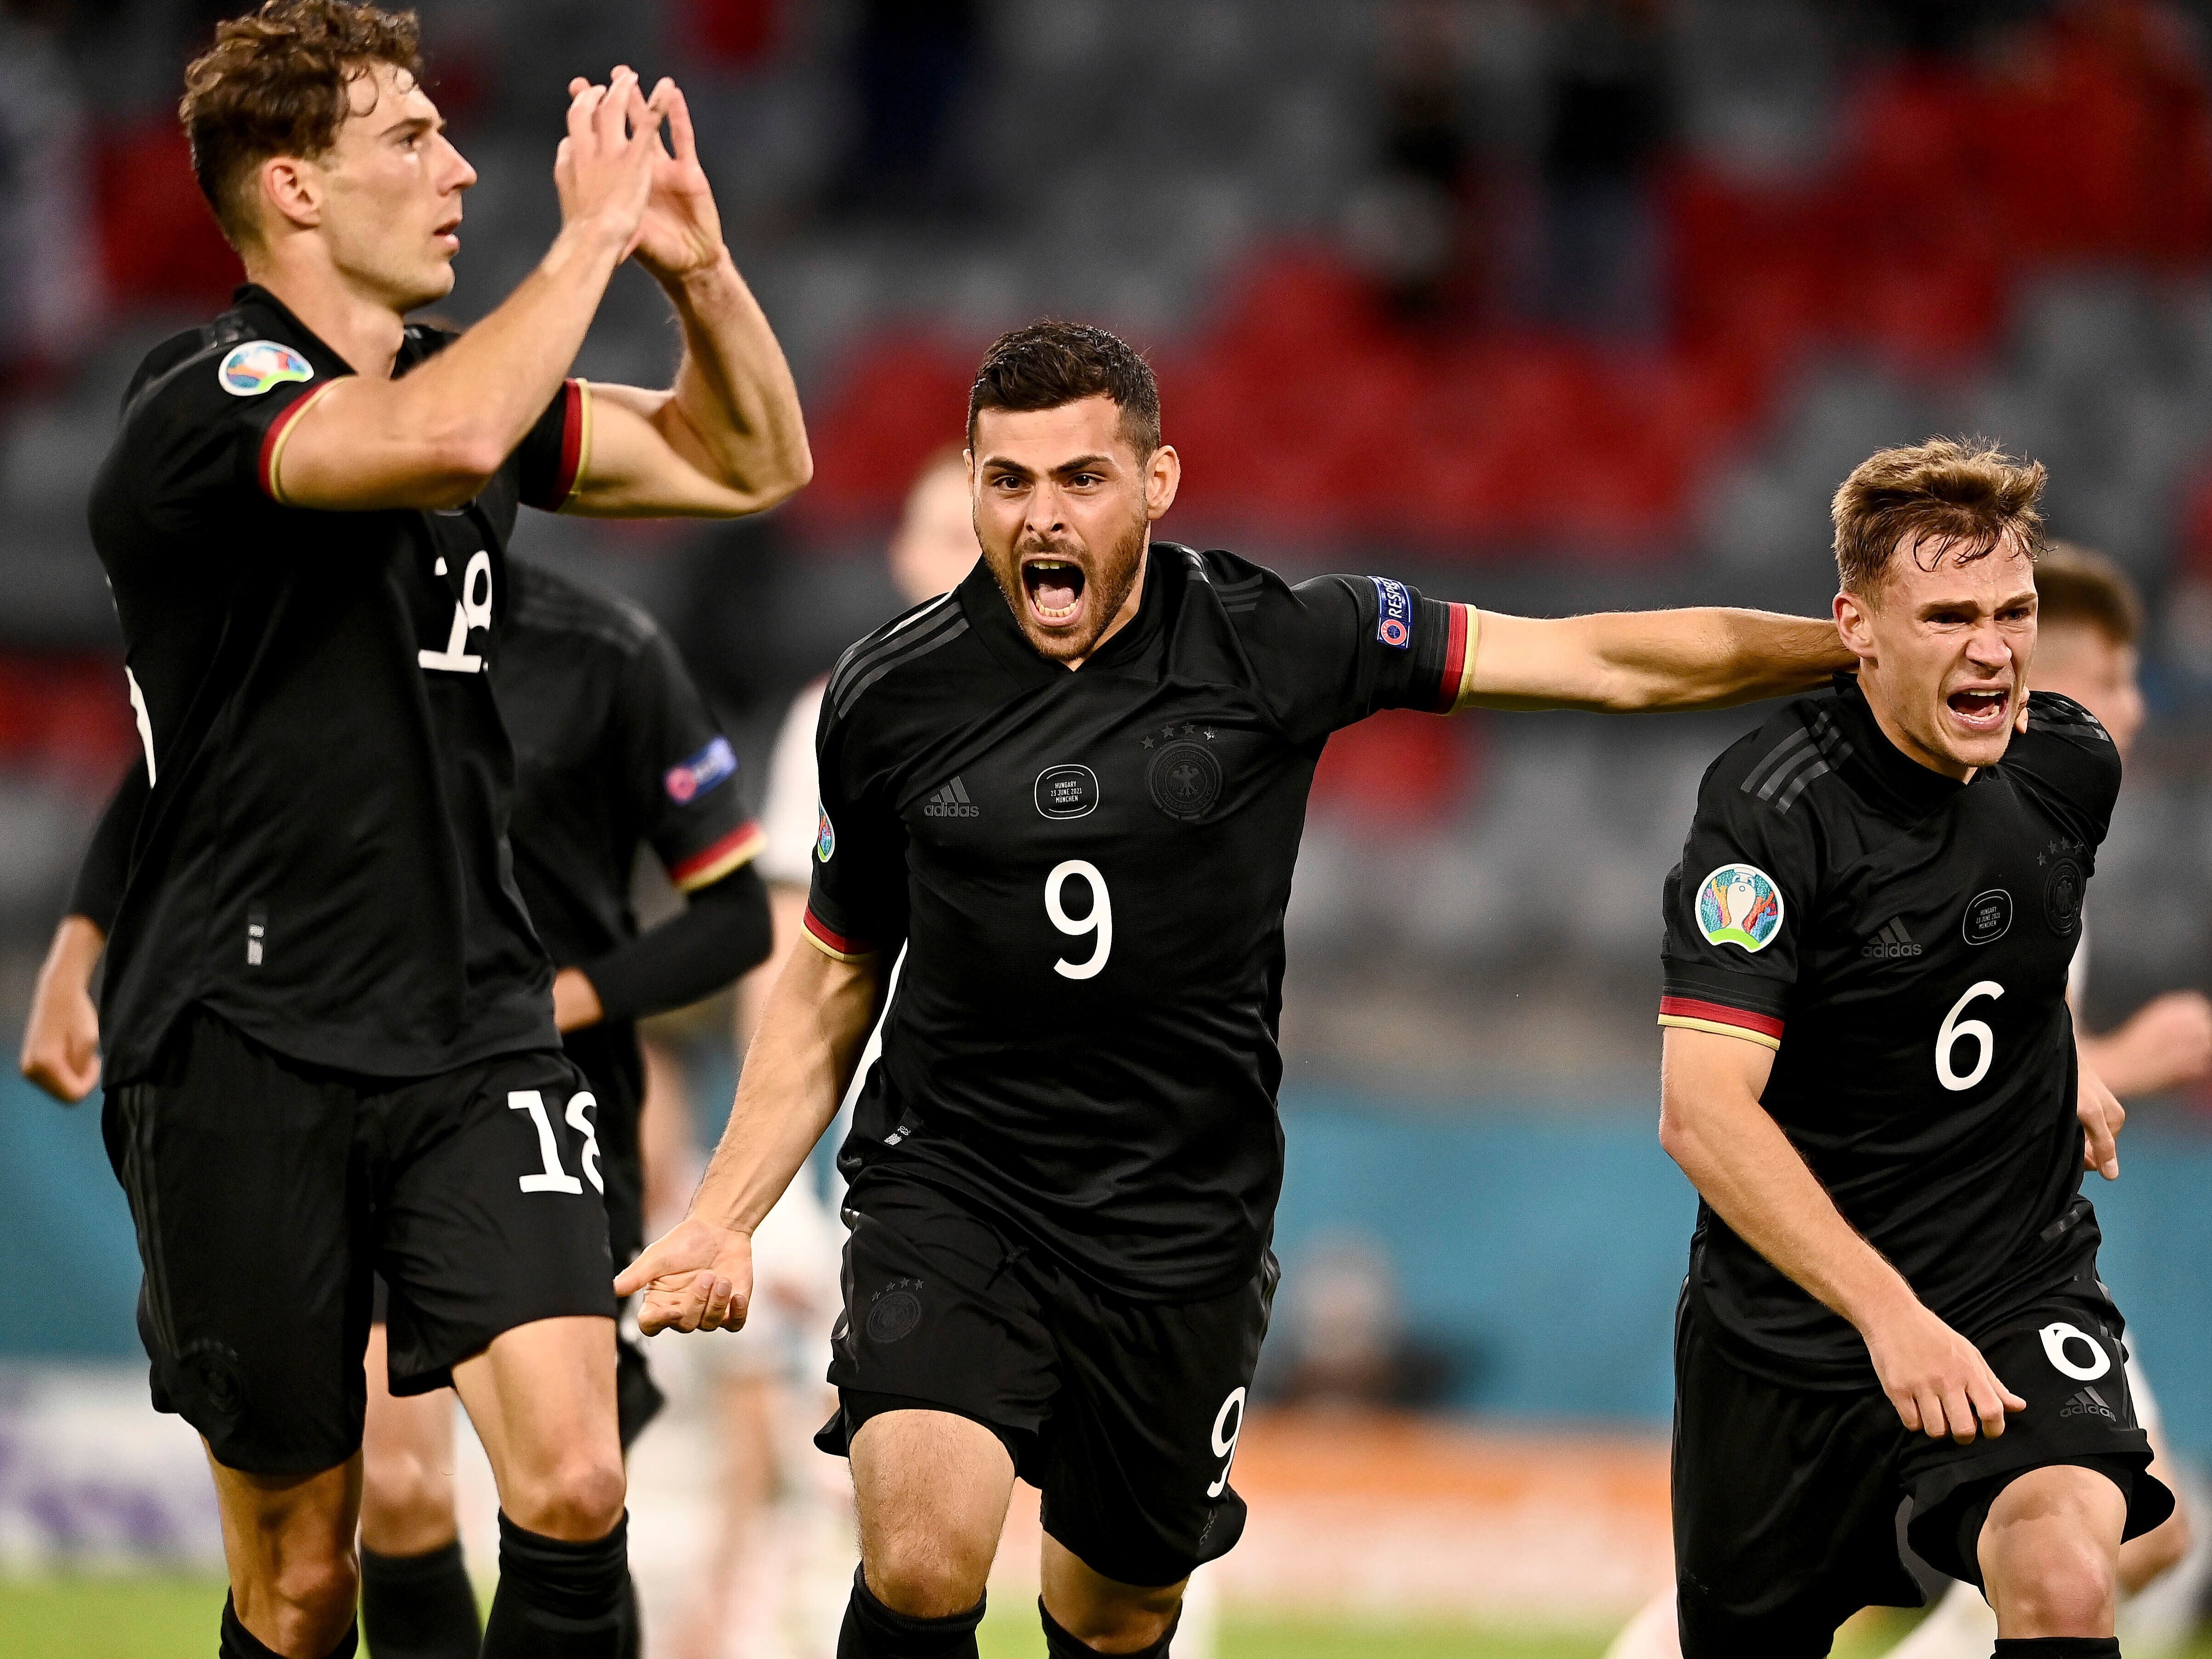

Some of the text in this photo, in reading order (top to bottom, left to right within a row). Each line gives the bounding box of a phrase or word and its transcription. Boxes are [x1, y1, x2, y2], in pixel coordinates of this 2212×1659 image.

[1055, 781, 1077, 789] HUNGARY
[1056, 795, 1078, 804] MÜNCHEN
[924, 802, 980, 817] adidas
[1045, 860, 1112, 980] 9
[1861, 942, 1922, 958] adidas
[1935, 981, 2005, 1091] 6
[1207, 1386, 1246, 1498] 9
